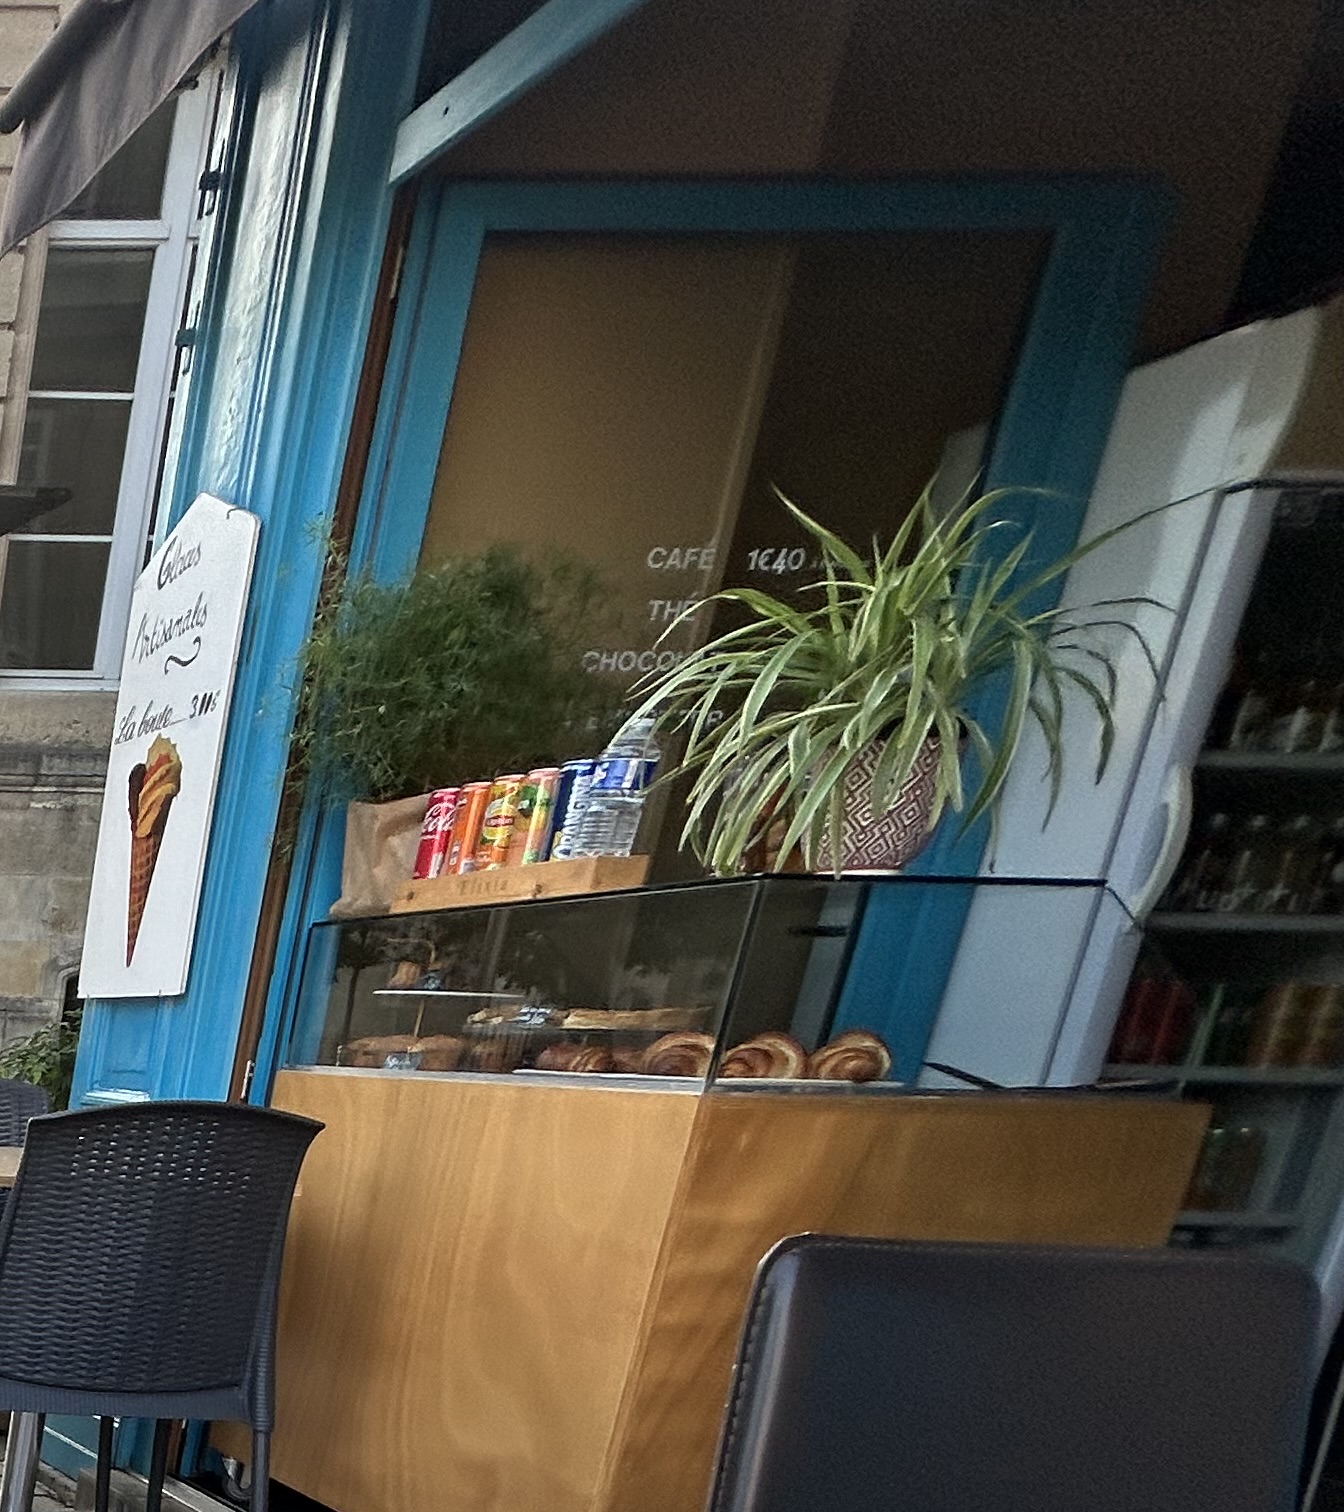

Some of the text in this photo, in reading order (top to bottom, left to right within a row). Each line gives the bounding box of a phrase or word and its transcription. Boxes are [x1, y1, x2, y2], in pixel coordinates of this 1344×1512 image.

[747, 548, 807, 575] 1€40
[114, 706, 137, 744] La
[137, 700, 174, 738] boule
